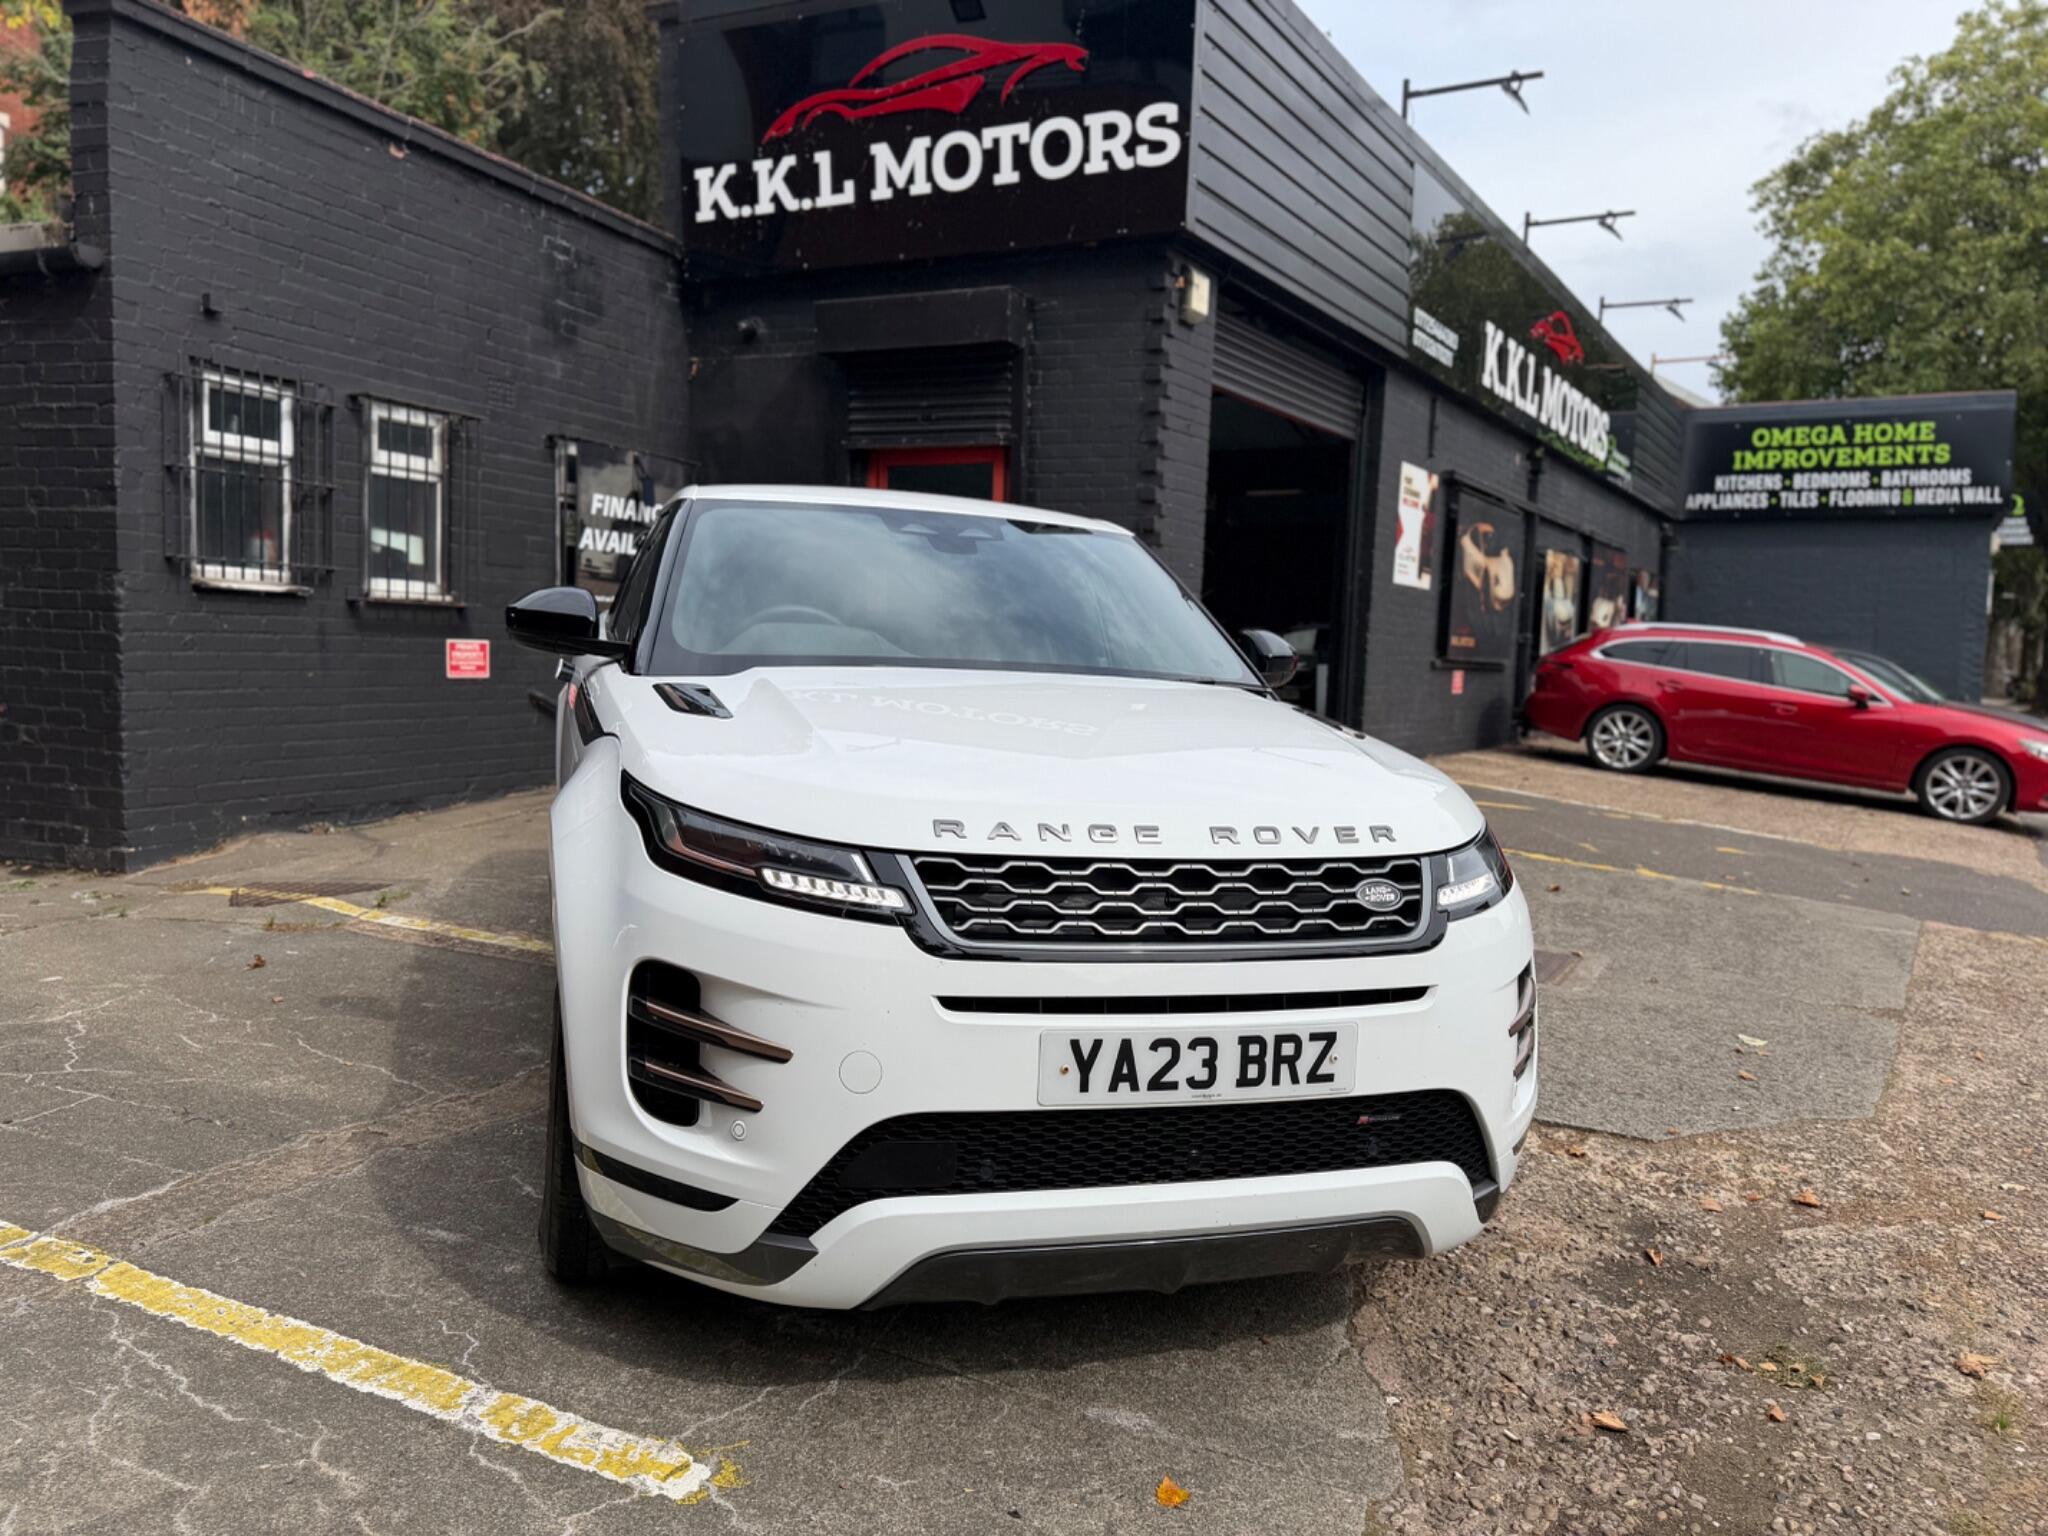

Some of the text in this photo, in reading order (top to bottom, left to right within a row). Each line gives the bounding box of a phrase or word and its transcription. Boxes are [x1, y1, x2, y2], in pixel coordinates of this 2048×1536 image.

[694, 101, 1182, 223] K.K.L MOTORS
[1539, 365, 1611, 463] MOTORS
[1751, 420, 1936, 448] OMEGA HOME
[1733, 443, 1952, 471] IMPROVEMENTS
[1714, 468, 1972, 491] KITCHENS BEDROOMS BATHROOMS
[590, 492, 663, 523] FINANC
[1685, 492, 1769, 511] APPLIANCES
[1778, 489, 1819, 508] TILES
[1828, 487, 1901, 507] FLOORING
[1914, 487, 1962, 506] MEDIA
[1962, 486, 2003, 505] WALL
[578, 526, 638, 556] AVAIL
[932, 818, 1397, 846] RANGE ROVER
[1069, 1031, 1338, 1094] YA23 BRZ
